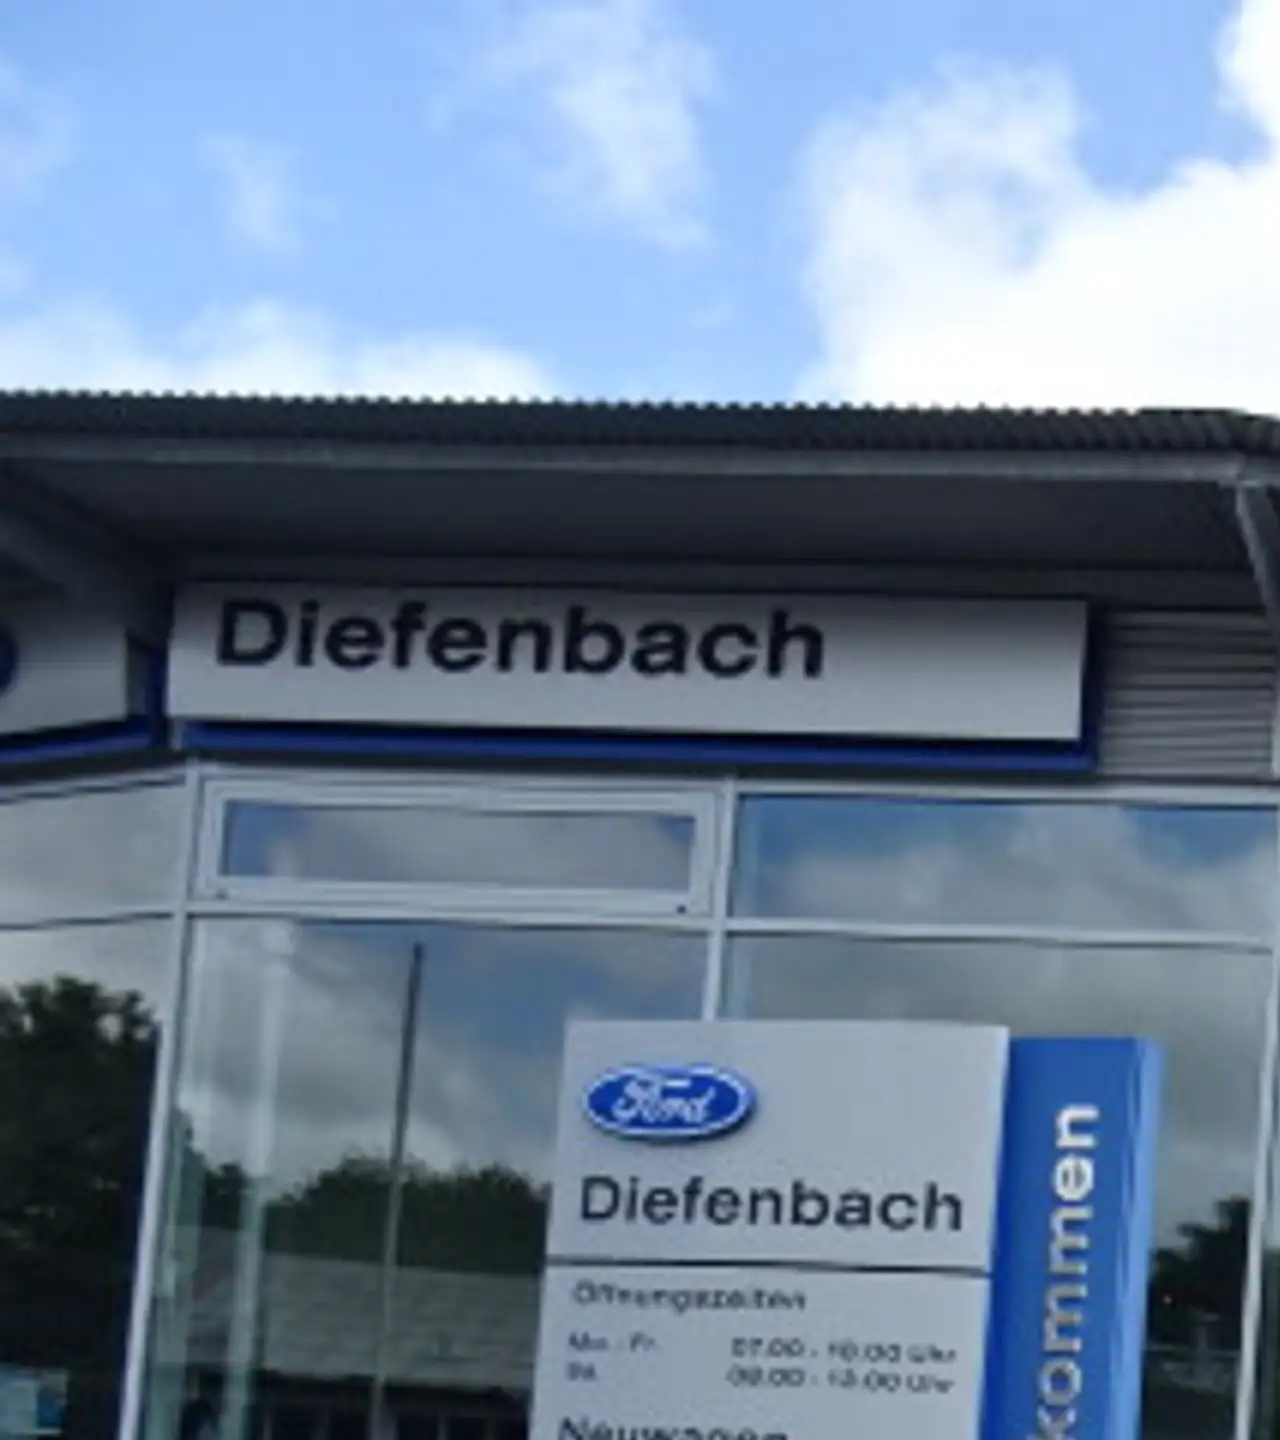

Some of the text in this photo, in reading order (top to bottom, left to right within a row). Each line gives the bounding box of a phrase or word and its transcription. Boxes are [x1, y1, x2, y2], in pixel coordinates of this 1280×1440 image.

[216, 600, 826, 682] Diefenbach
[612, 1075, 717, 1124] Ford
[580, 1175, 965, 1233] Diefenbach
